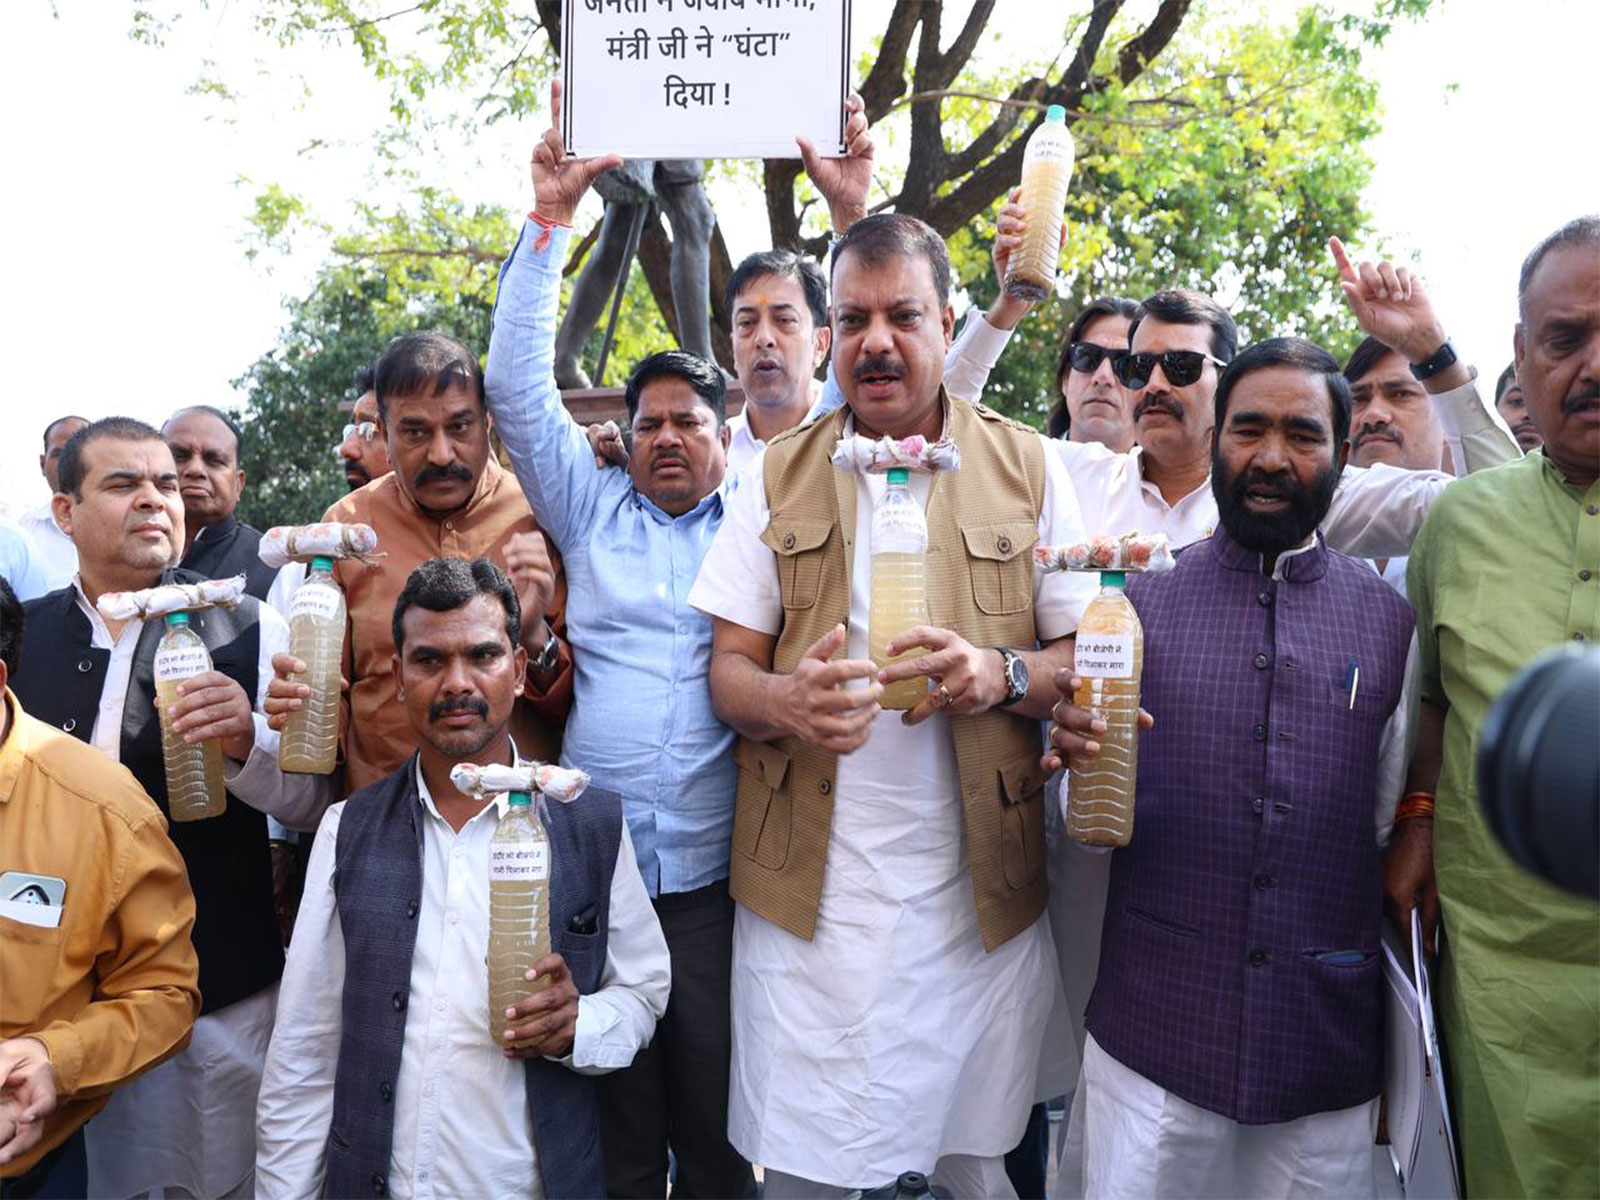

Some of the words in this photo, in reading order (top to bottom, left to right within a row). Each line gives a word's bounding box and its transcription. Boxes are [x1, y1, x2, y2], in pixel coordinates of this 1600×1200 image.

[605, 28, 651, 61] मंत्री
[657, 26, 689, 60] जी
[694, 25, 714, 59] ने
[663, 74, 717, 109] दिया
